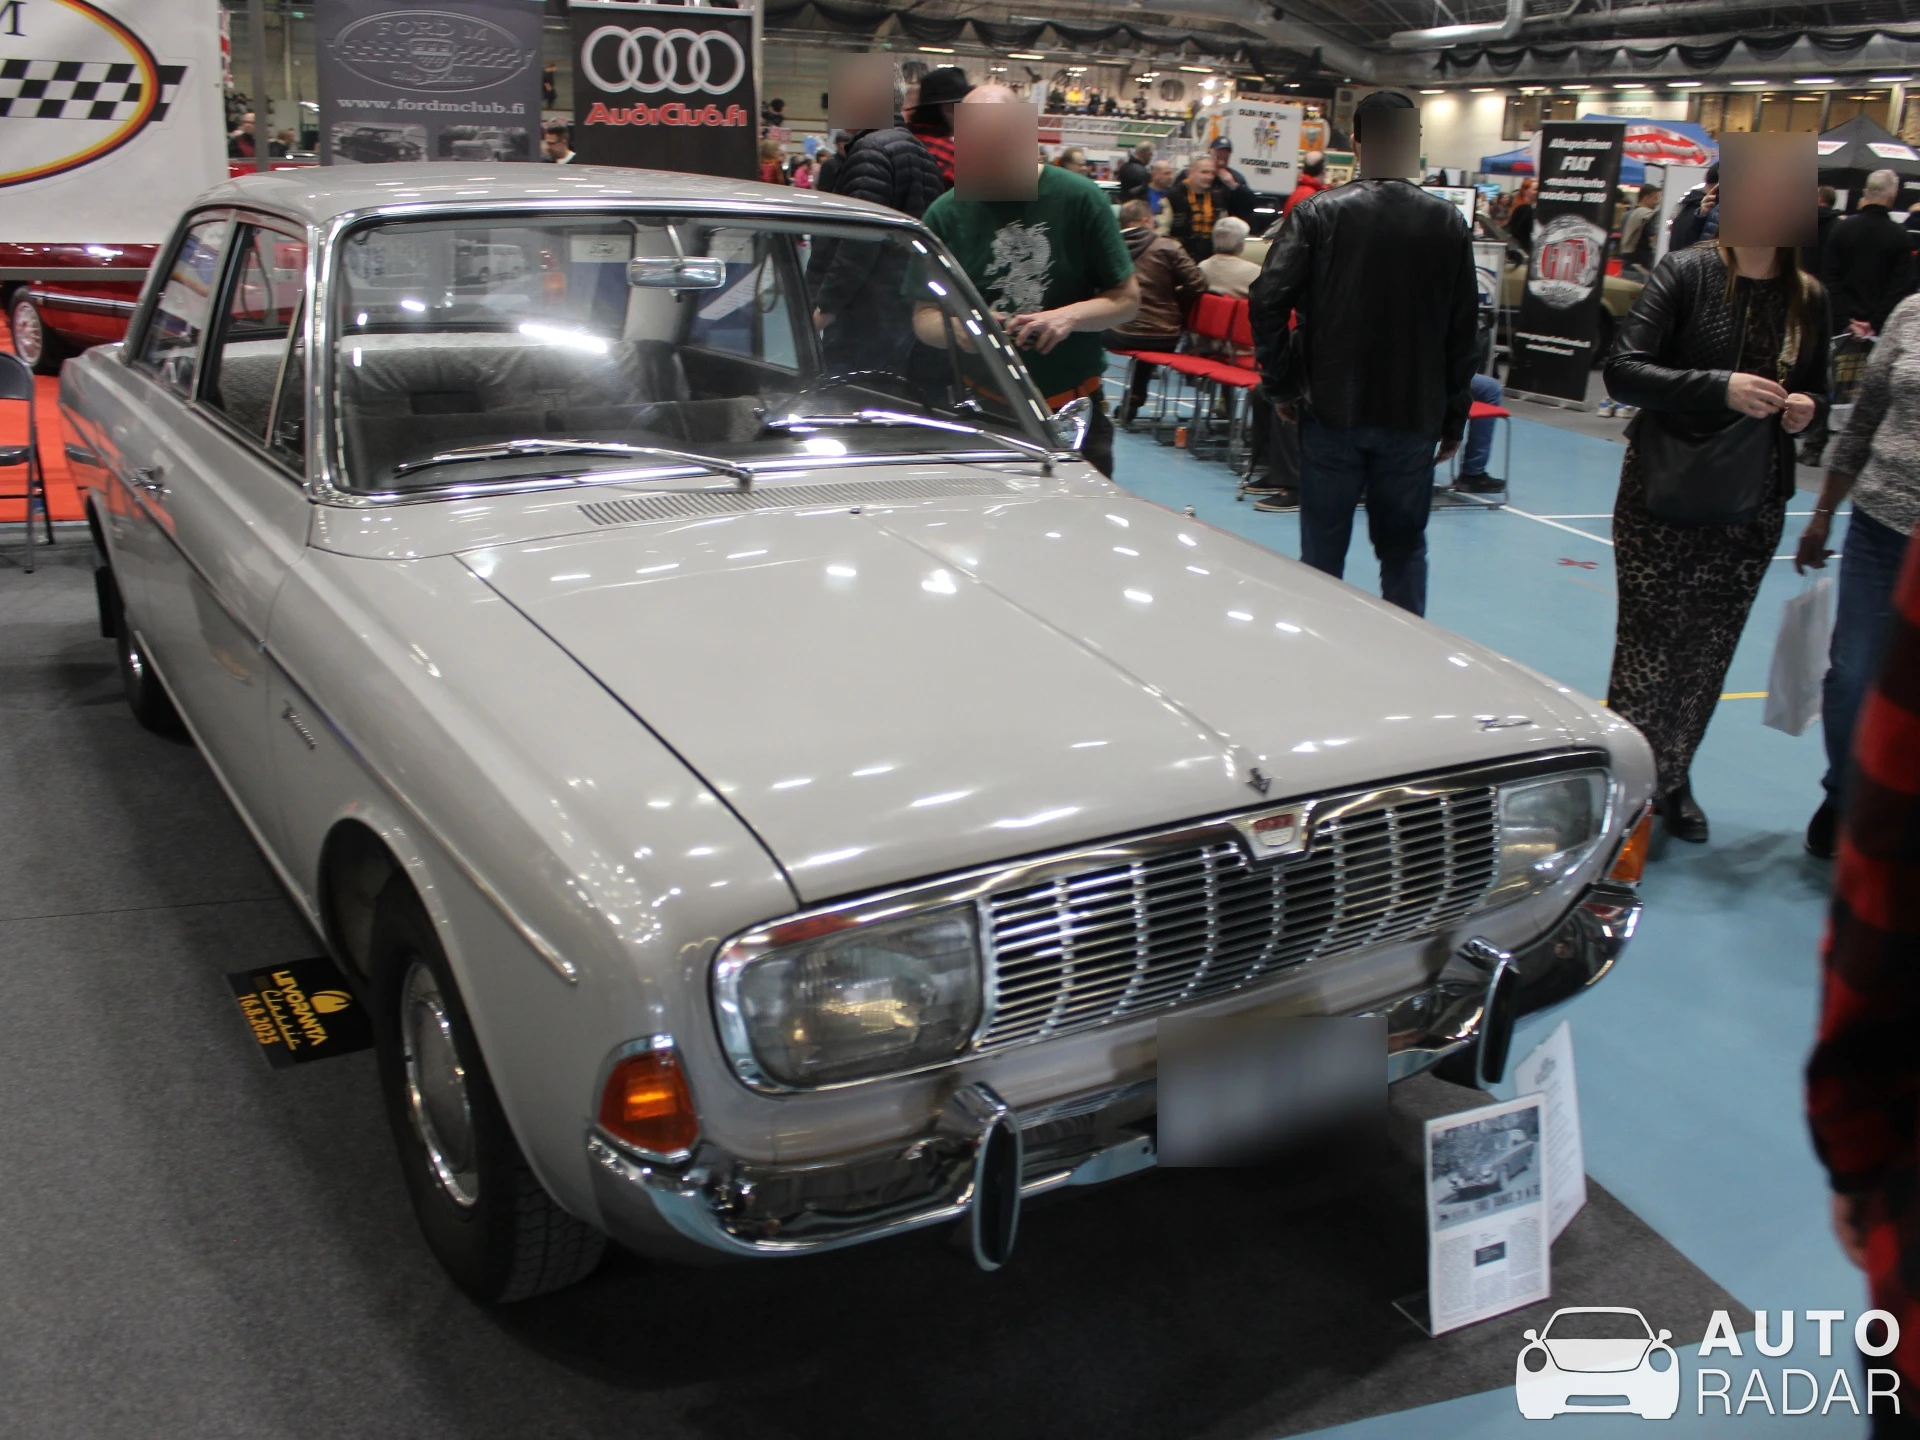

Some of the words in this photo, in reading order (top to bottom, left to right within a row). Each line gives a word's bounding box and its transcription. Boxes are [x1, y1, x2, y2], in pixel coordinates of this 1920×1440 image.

[375, 20, 456, 38] FORD
[336, 98, 525, 115] www.fordmclub.fi
[1559, 155, 1597, 171] FIAT
[237, 993, 282, 1045] 16.8.2025
